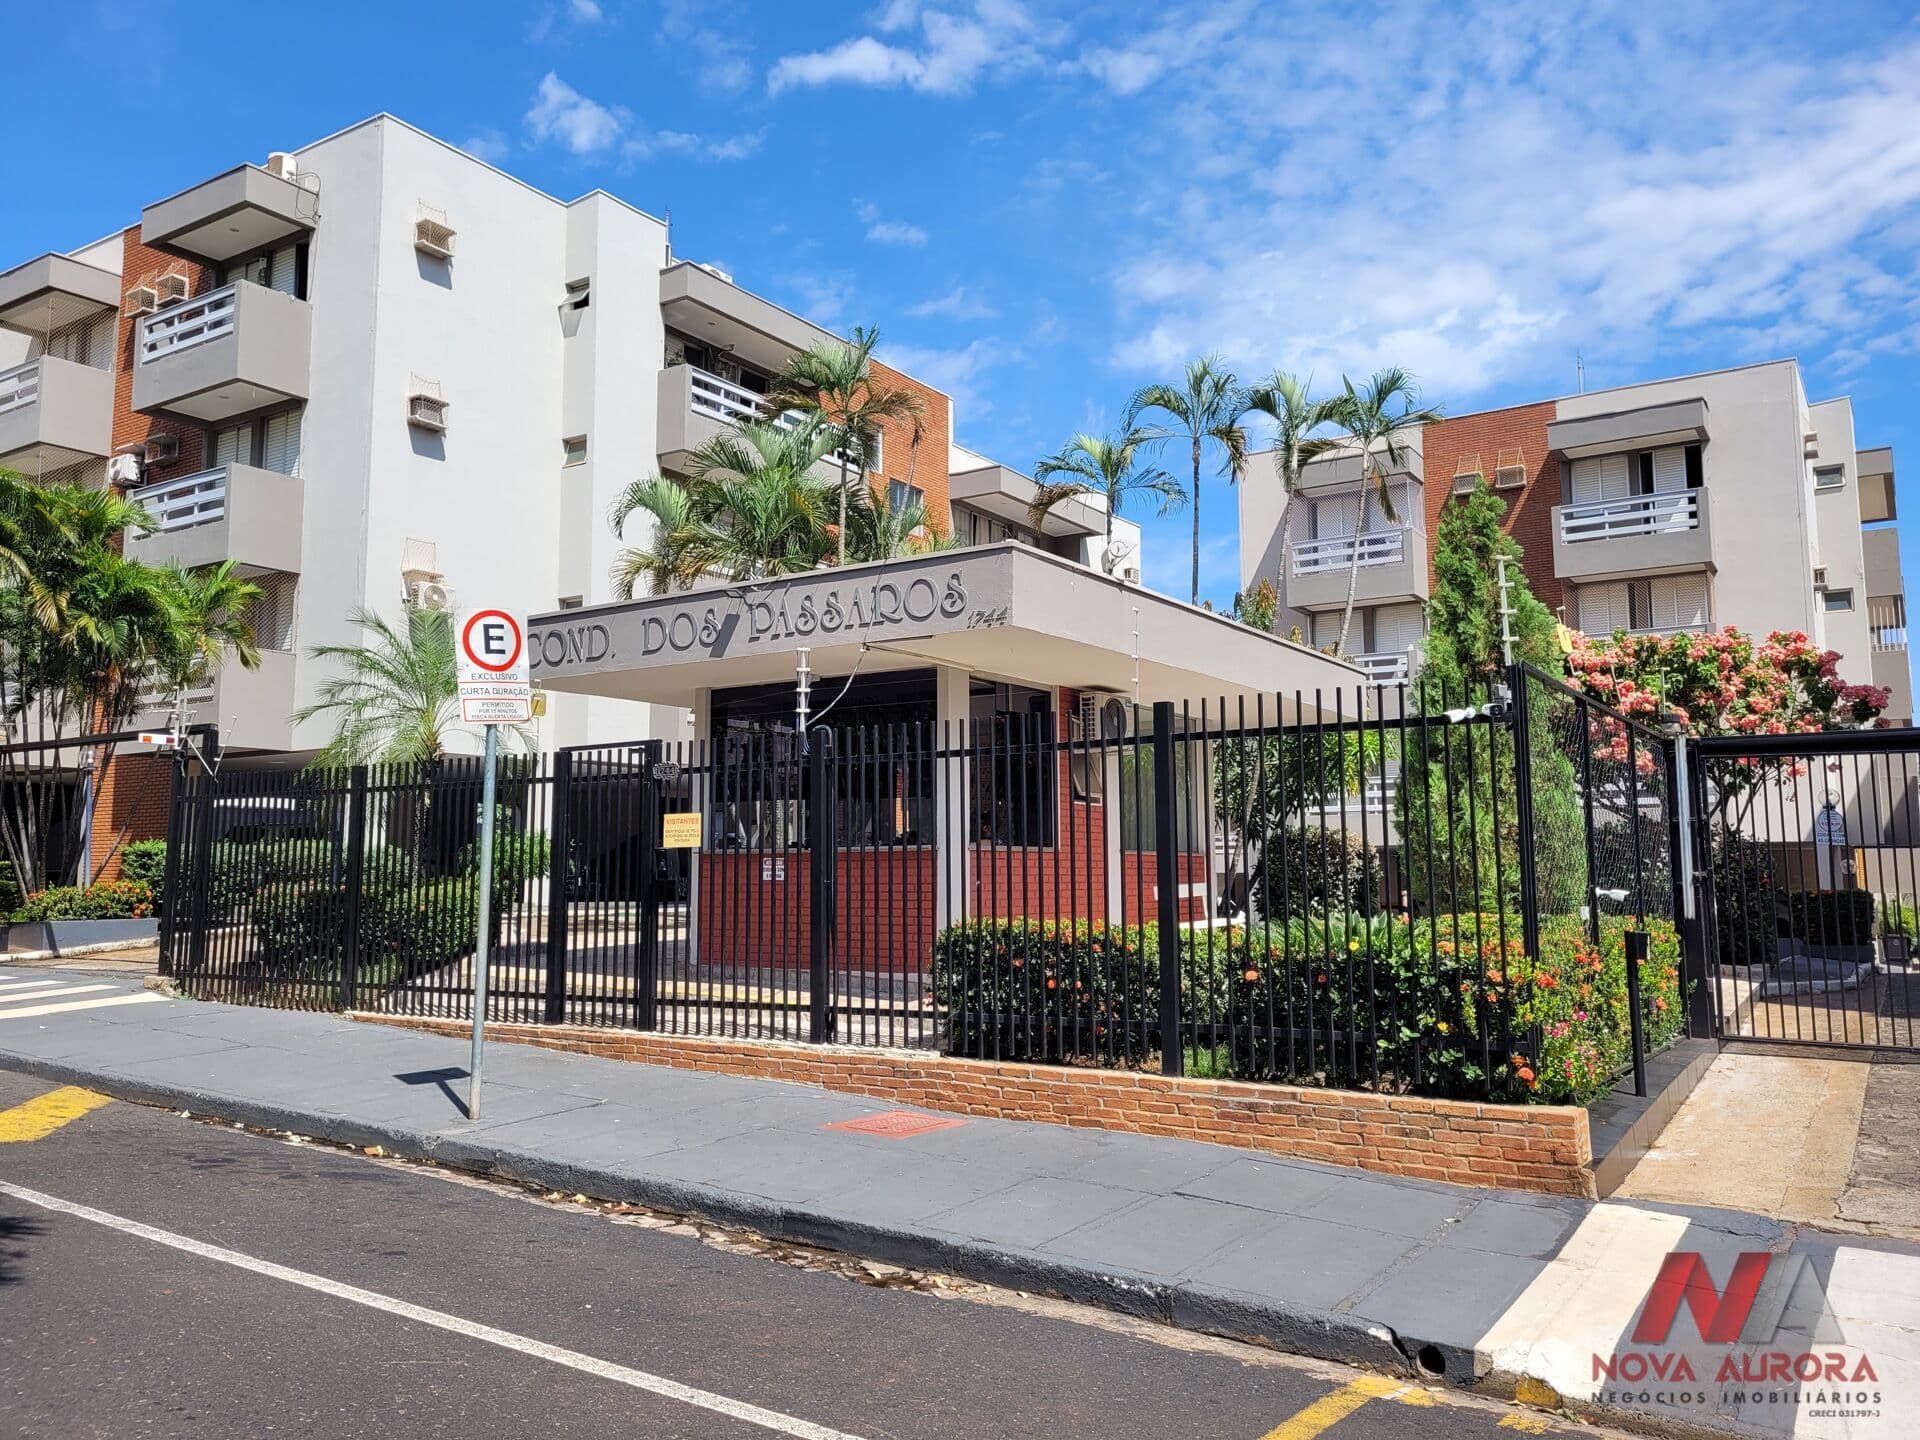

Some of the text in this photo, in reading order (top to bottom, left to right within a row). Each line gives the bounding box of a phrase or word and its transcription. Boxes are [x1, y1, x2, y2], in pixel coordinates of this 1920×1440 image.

[967, 606, 1008, 629] 1744
[483, 624, 506, 655] E
[528, 624, 616, 669] COND.
[641, 607, 721, 656] DOS
[492, 687, 528, 696] DURAÇÃO
